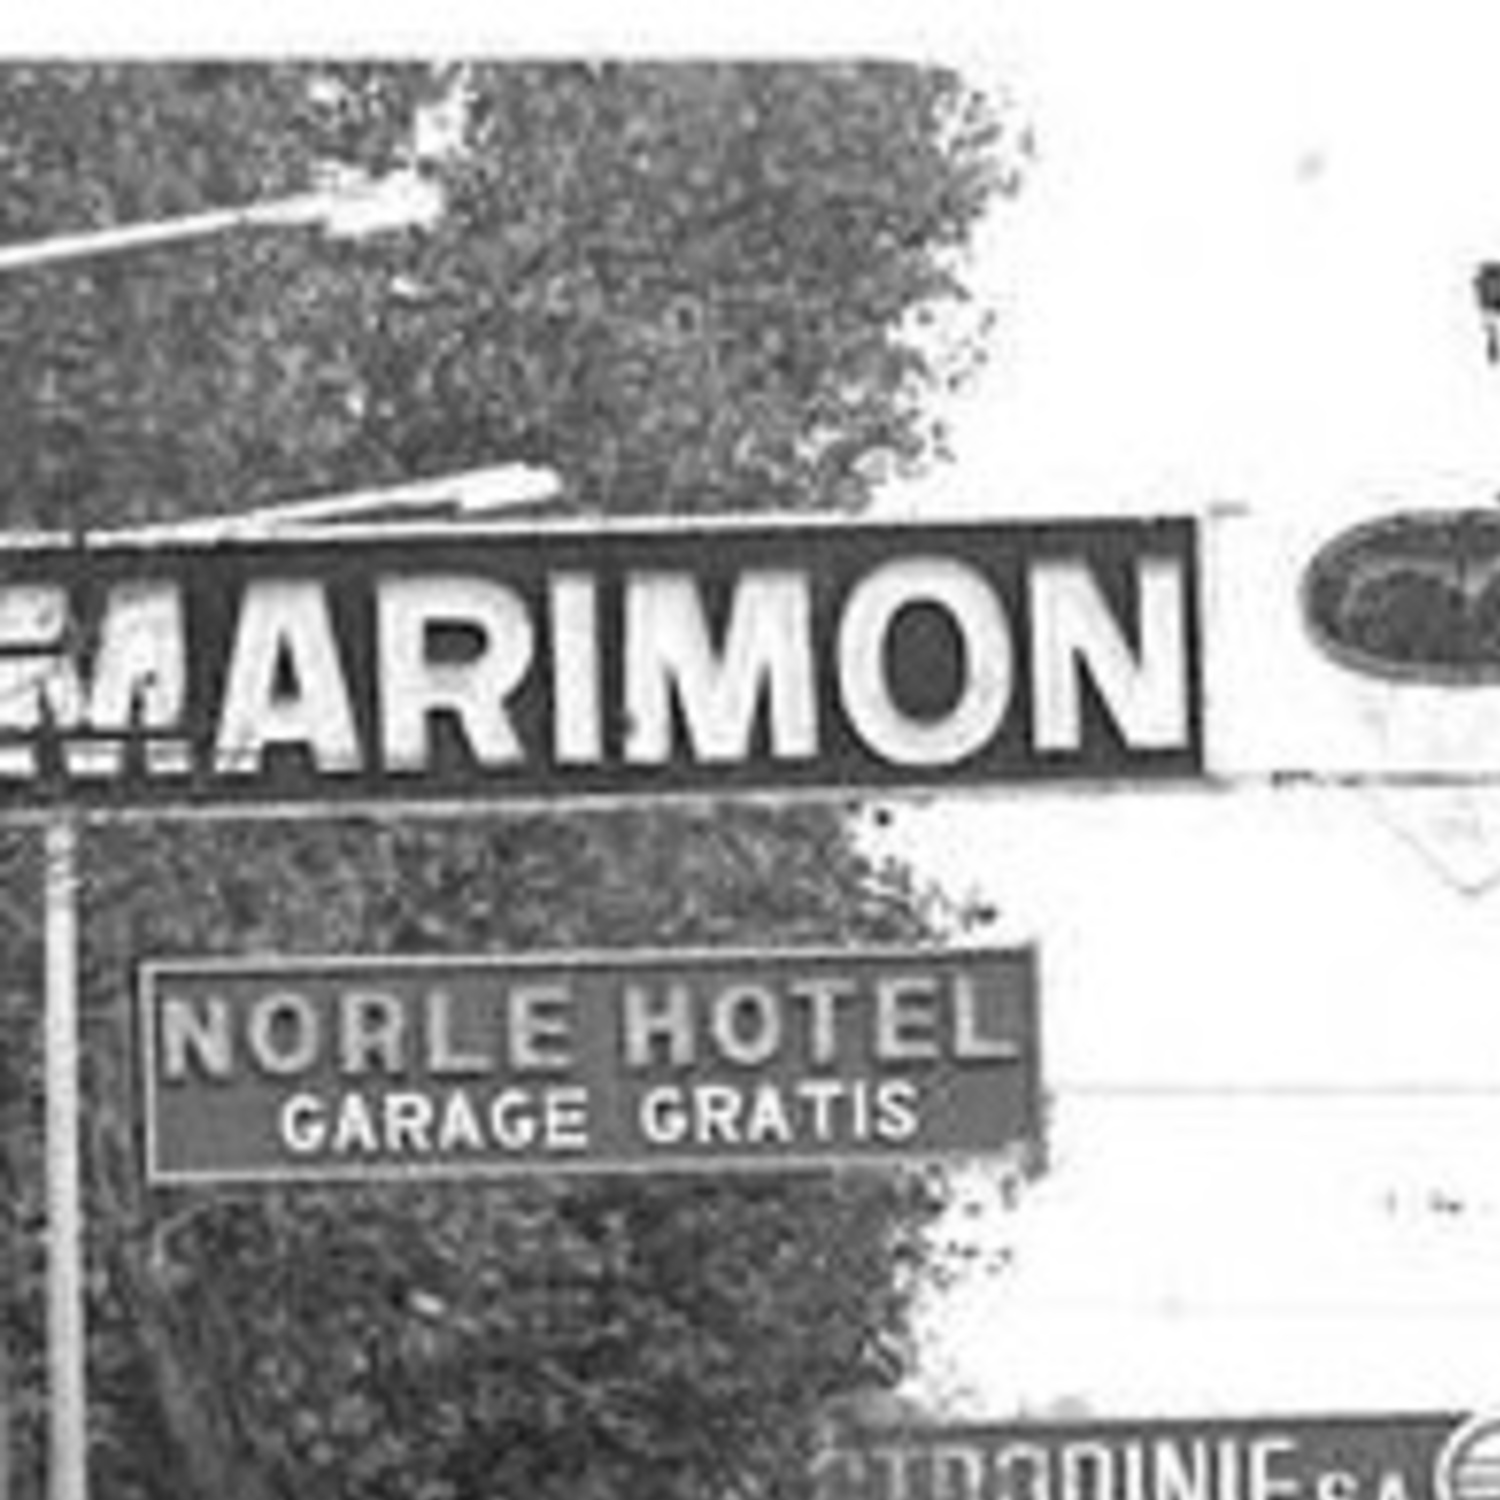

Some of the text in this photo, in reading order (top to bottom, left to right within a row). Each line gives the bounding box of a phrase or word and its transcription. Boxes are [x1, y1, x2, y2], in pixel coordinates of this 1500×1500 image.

[0, 556, 1190, 776] MARIMON
[160, 974, 1019, 1078] NORLE HOTEL
[278, 1080, 920, 1154] GARAGE GRATIS
